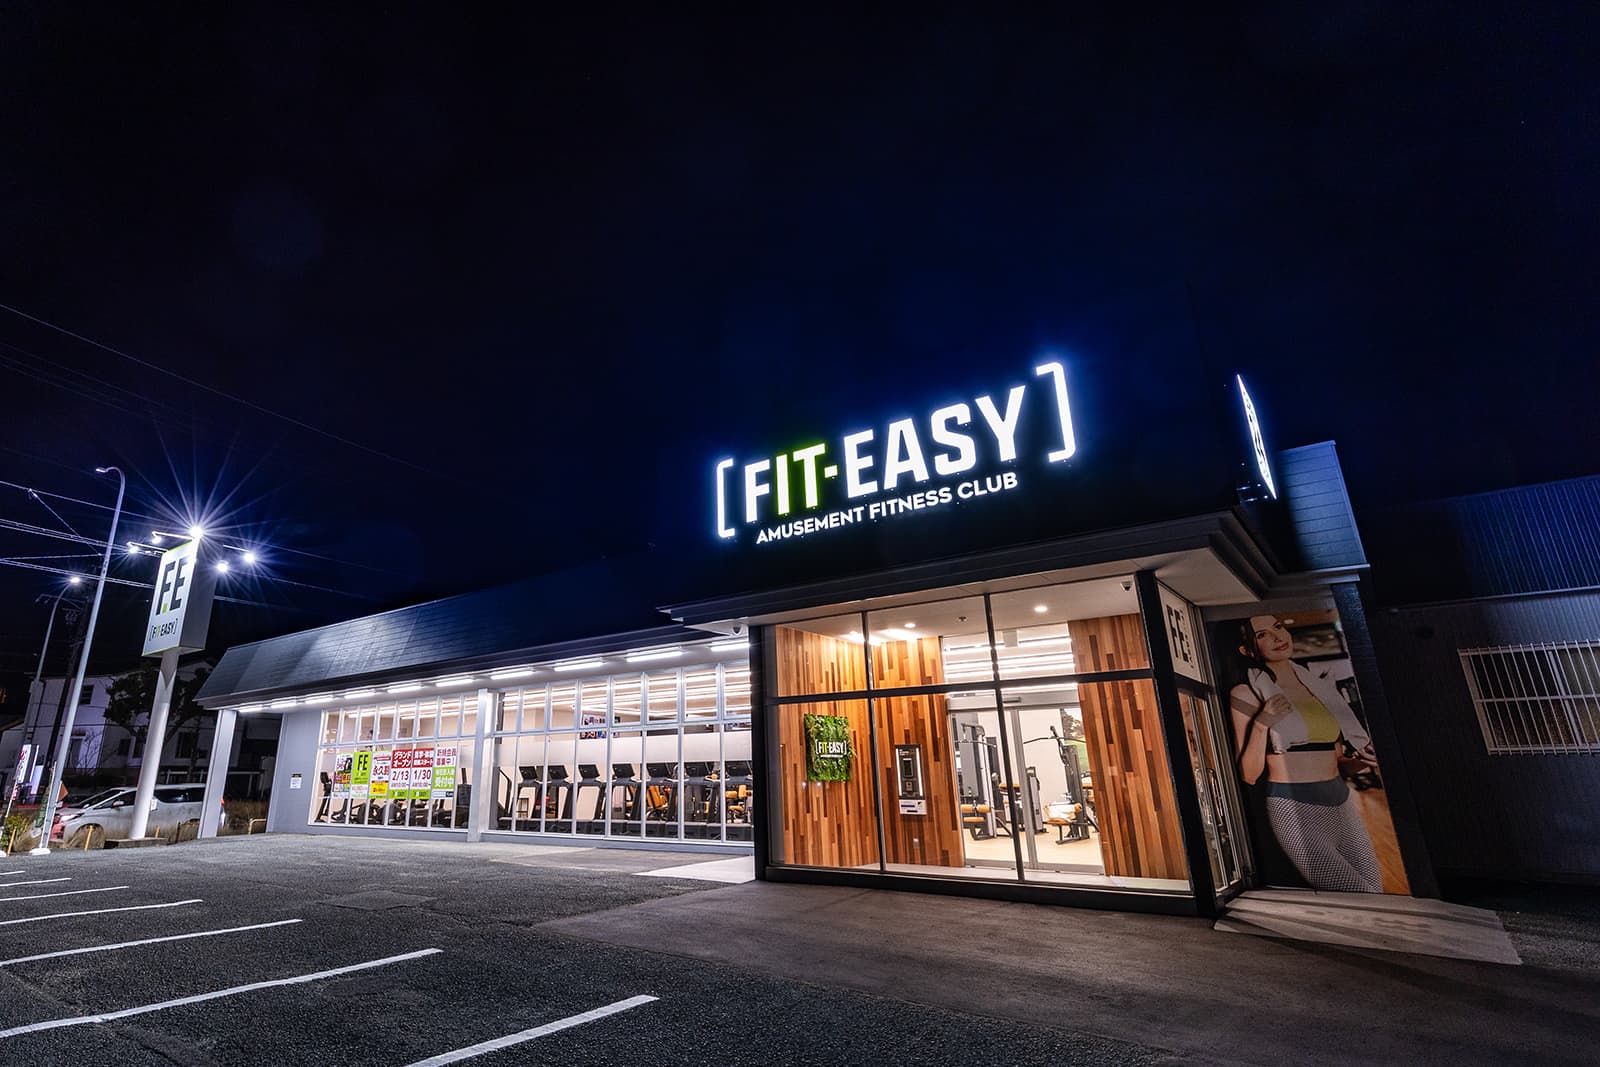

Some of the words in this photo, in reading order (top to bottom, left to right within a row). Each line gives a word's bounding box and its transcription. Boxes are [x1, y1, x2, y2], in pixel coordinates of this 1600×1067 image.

[756, 506, 865, 544] AMUSEMENT
[869, 486, 953, 520] FITNESS
[957, 471, 1019, 500] CLUB
[392, 770, 409, 781] 2/13
[413, 769, 431, 780] 1/30
